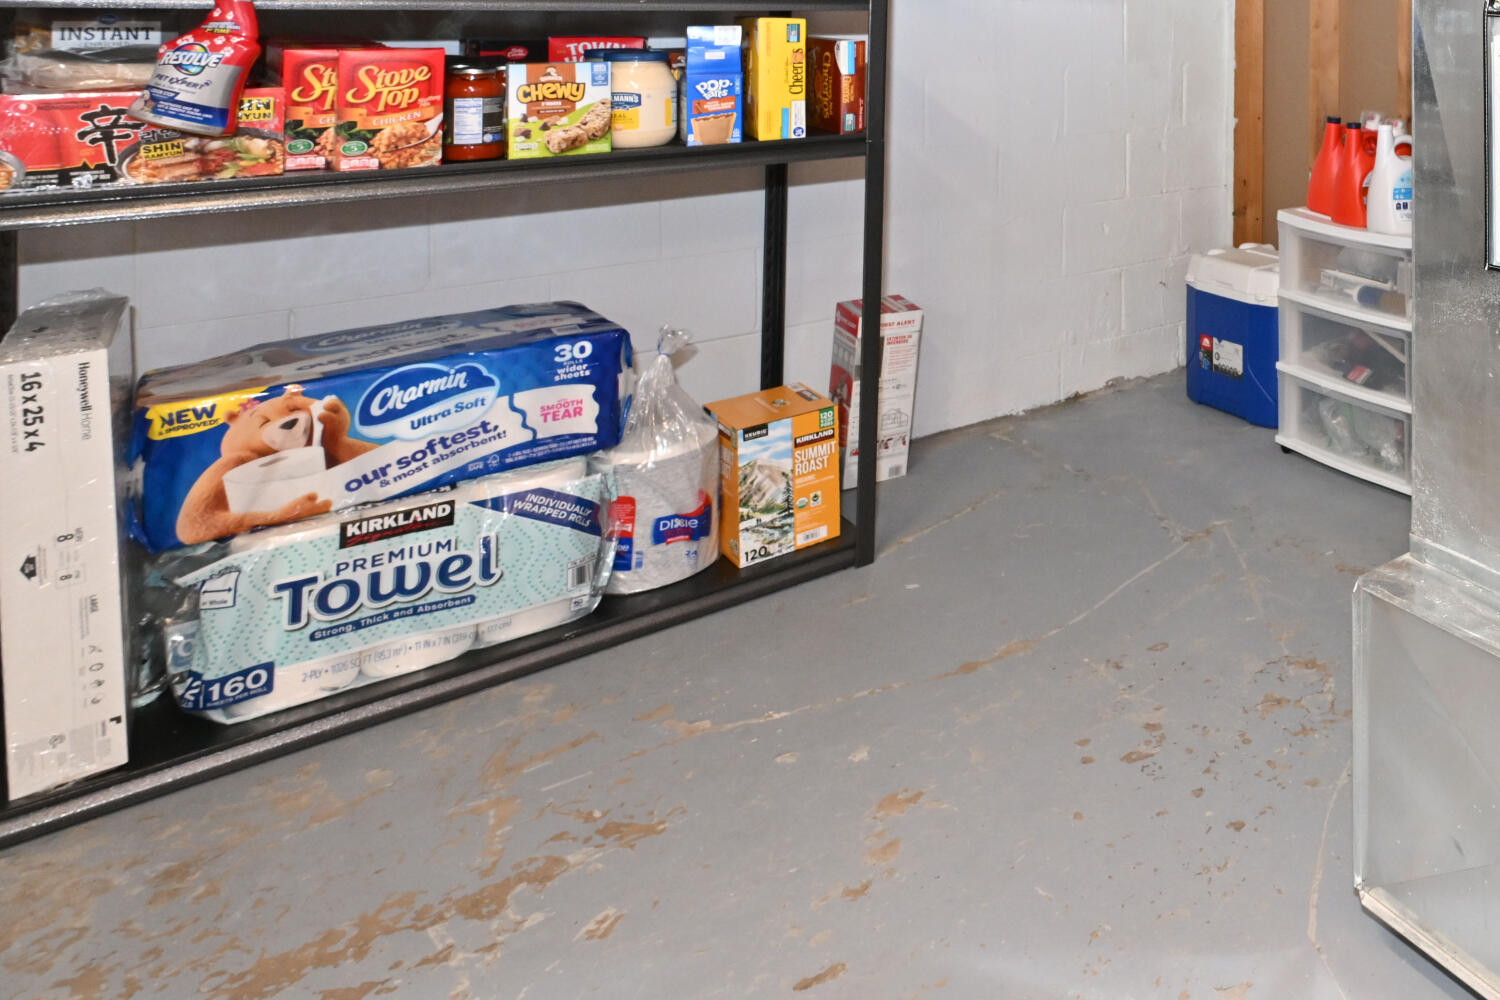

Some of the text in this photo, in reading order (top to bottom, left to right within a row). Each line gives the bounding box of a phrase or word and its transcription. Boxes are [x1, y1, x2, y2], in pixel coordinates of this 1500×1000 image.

[60, 26, 155, 41] INSTANT
[159, 51, 224, 68] RESOLVE
[346, 64, 432, 104] Stove
[377, 87, 420, 113] Top
[372, 111, 422, 127] CHICKEN
[142, 142, 183, 155] SHIN
[554, 340, 593, 363] 30
[554, 369, 591, 382] sheets
[557, 363, 589, 375] wider
[77, 361, 93, 413] Honeywell
[368, 366, 469, 418] Charmin
[20, 371, 46, 453] 16 x 25 x 4
[160, 403, 217, 429] NEW
[409, 396, 487, 432] Ultra Soft
[539, 399, 584, 413] SMOOTH
[540, 406, 584, 424] TEAR
[795, 428, 834, 444] KIRKLAND
[344, 461, 393, 494] our
[396, 419, 500, 473] softest,
[392, 463, 429, 485] most
[430, 429, 508, 471] absorbent!
[795, 440, 837, 465] SUMMIT
[795, 455, 829, 477] ROAST
[512, 498, 566, 523] WRAPPED
[525, 492, 593, 517] INDIVIDUALLY
[345, 502, 453, 539] KIRKLAND
[335, 538, 453, 578] PREMIUM
[744, 545, 768, 563] 120
[276, 534, 499, 628] Towel
[314, 596, 473, 641] Strong, Thick and Absorbent
[207, 668, 269, 698] 160
